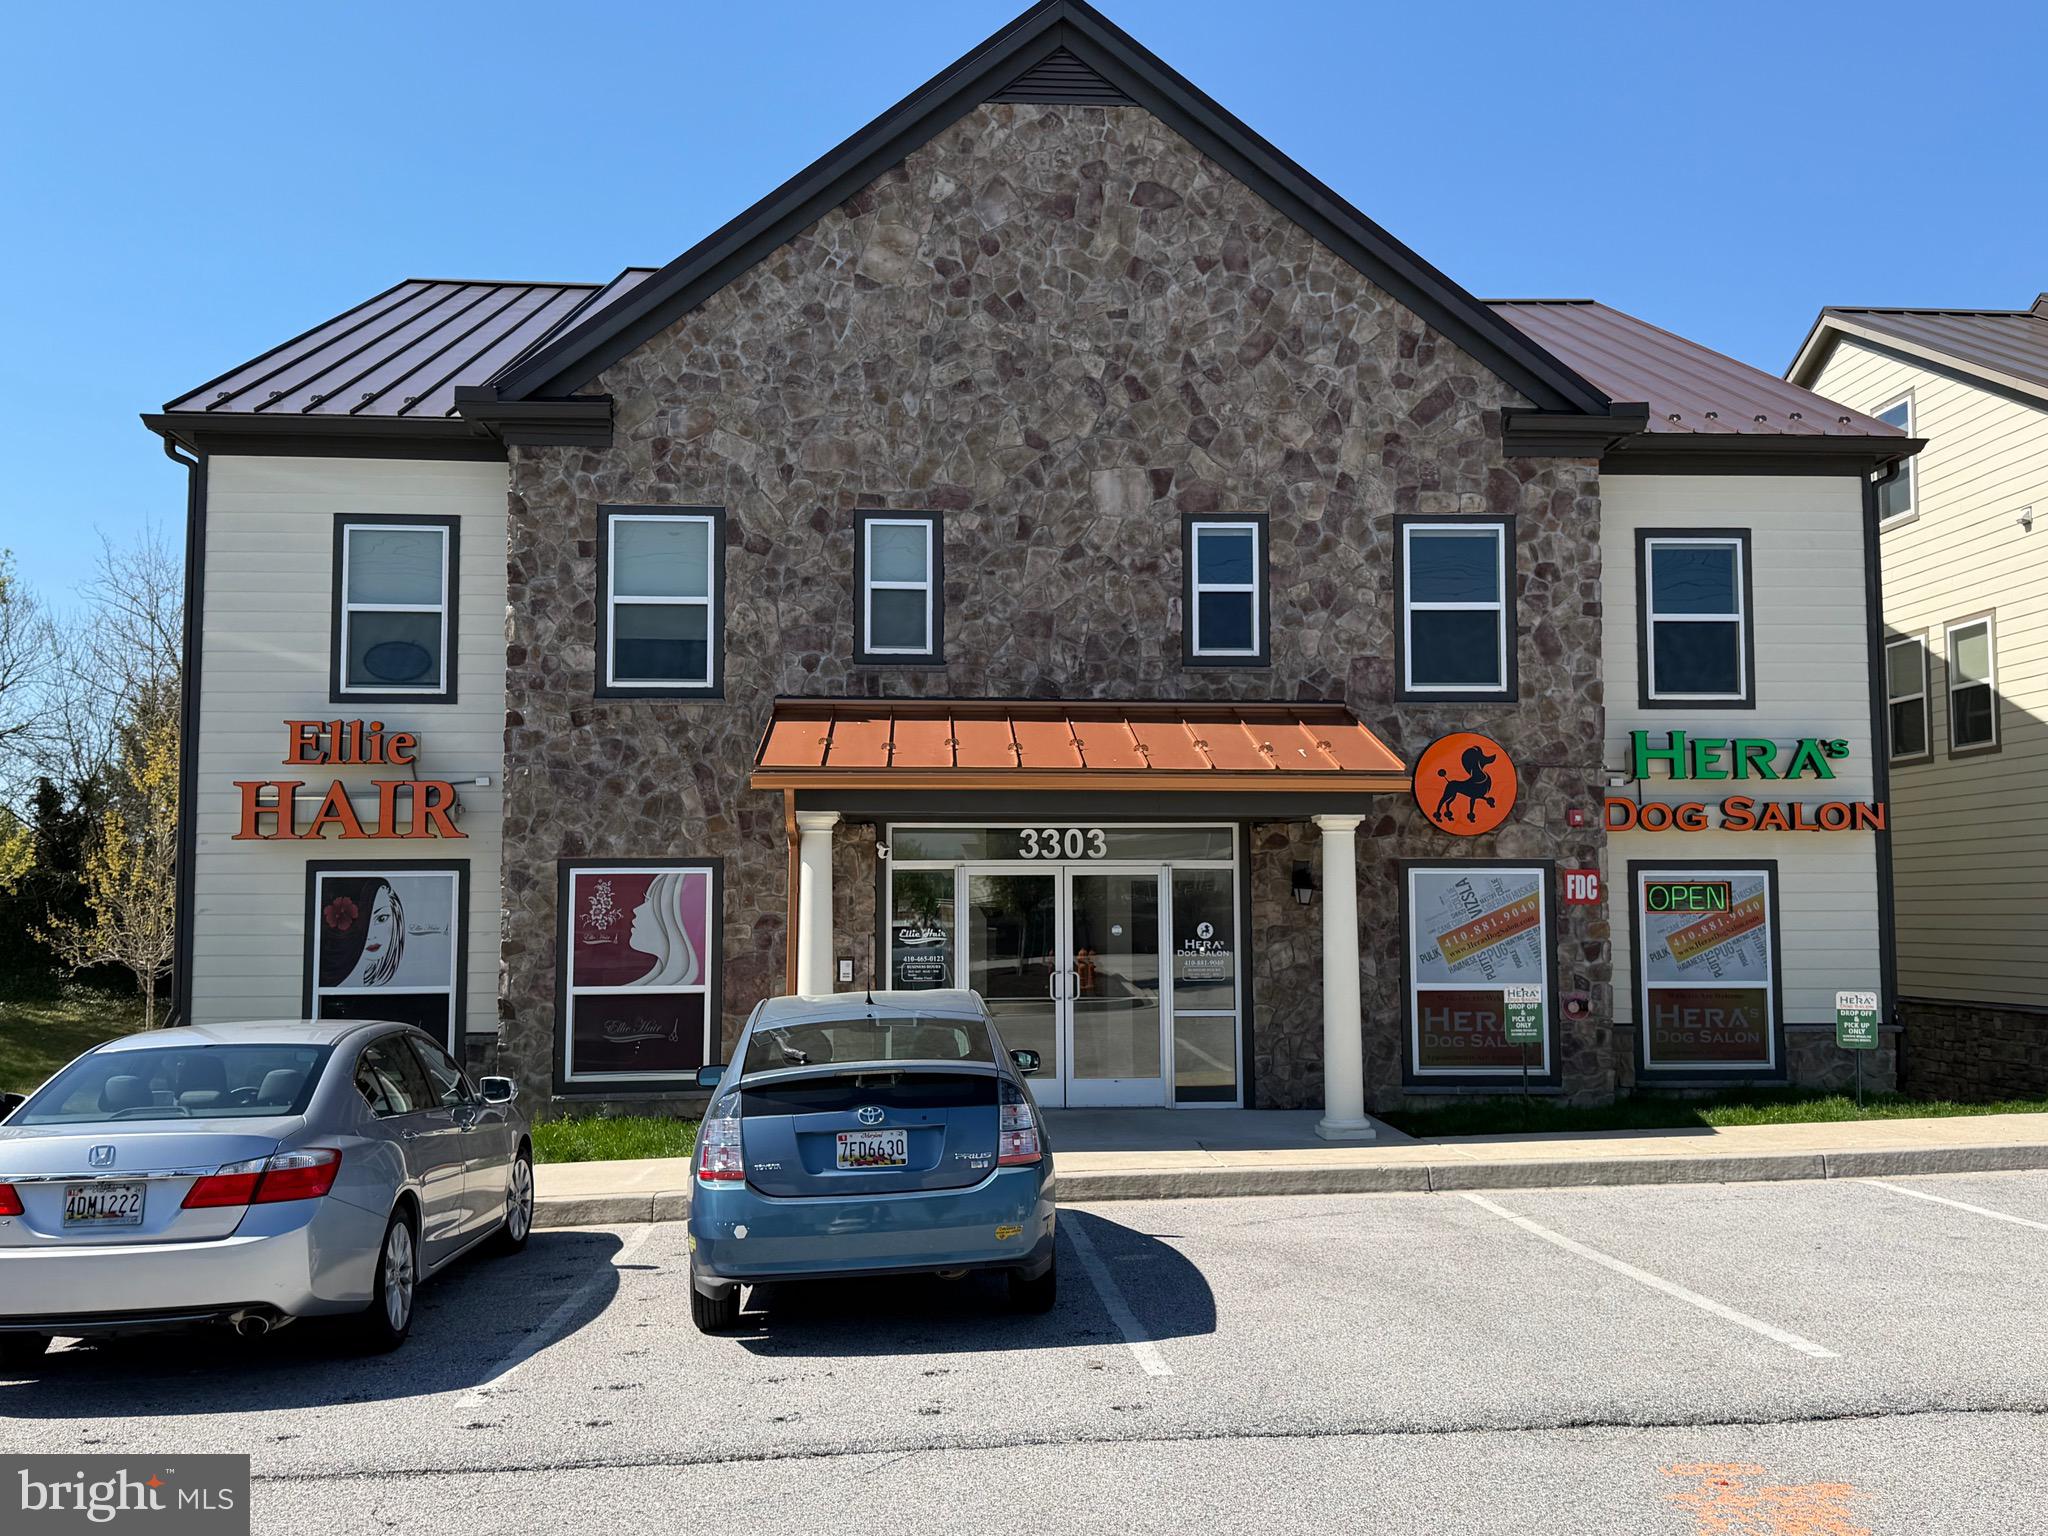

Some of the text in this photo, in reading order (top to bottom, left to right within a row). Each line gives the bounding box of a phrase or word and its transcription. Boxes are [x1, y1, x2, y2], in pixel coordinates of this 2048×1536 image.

[282, 719, 417, 765] Ellie
[231, 779, 469, 839] HAIR
[1604, 795, 1886, 832] DOG SALON
[1018, 828, 1108, 859] 3303
[1455, 877, 1483, 919] VIZSLA
[1566, 874, 1598, 900] FDC
[1648, 885, 1725, 911] OPEN
[899, 928, 920, 938] Ellie
[1444, 901, 1536, 948] 410.881.9040
[1672, 901, 1760, 947] 410.881.9040
[1177, 949, 1197, 957] DOG
[1485, 943, 1509, 962] PUG
[1713, 942, 1735, 960] PUG
[1424, 1007, 1504, 1032] HER
[1655, 1029, 1760, 1043] DOG SALON
[840, 1139, 904, 1159] 7FD6630
[66, 1194, 140, 1216] 4DM1222
